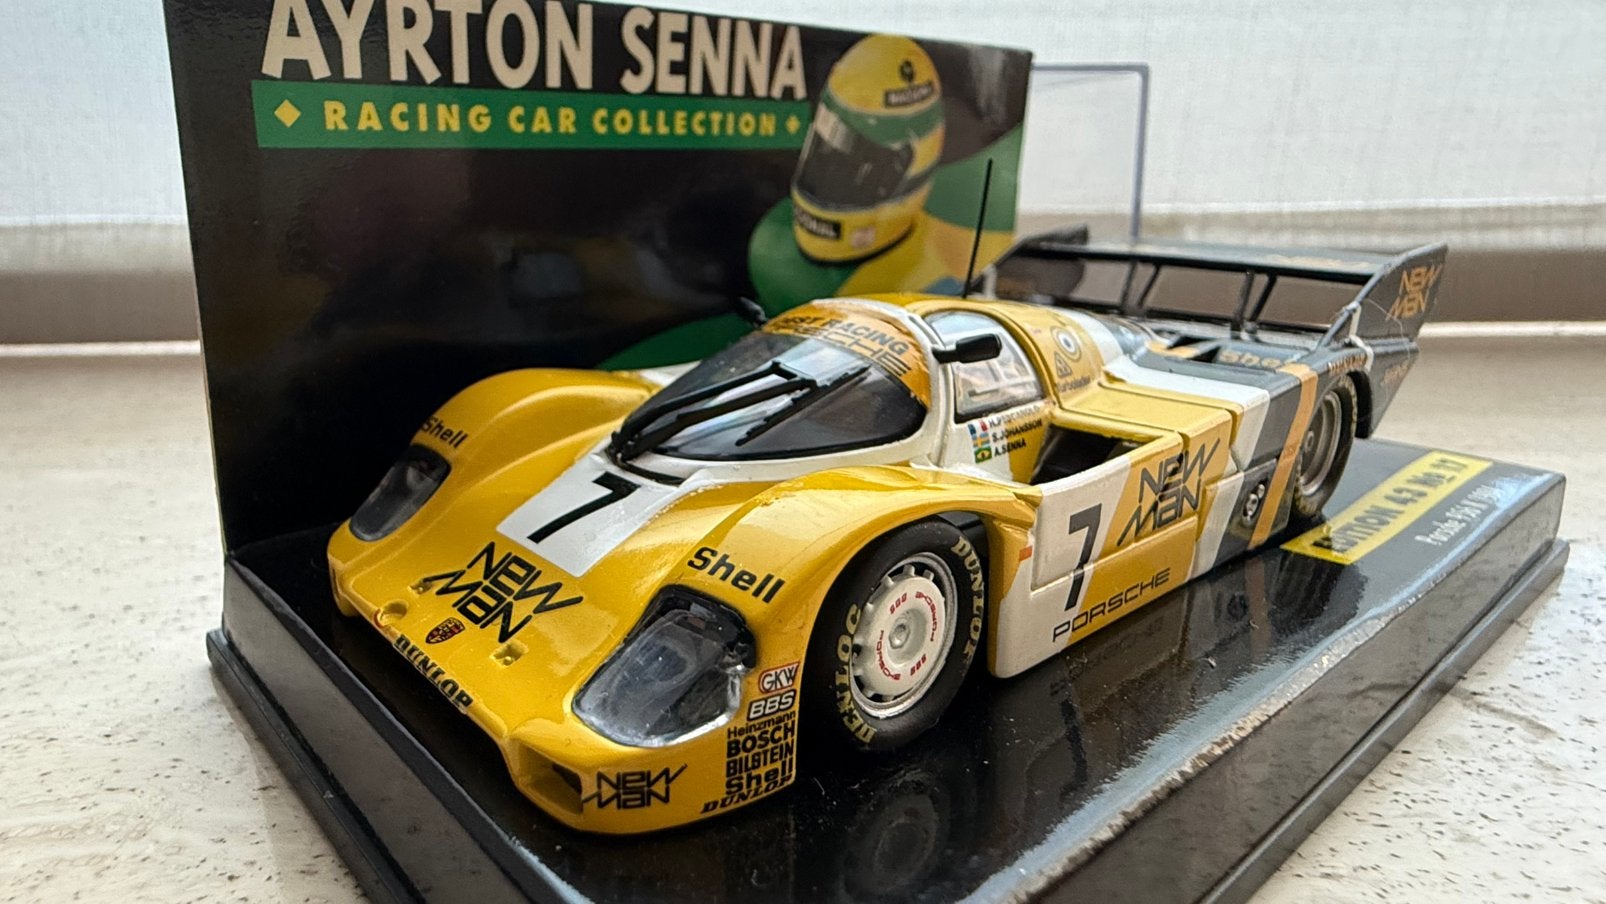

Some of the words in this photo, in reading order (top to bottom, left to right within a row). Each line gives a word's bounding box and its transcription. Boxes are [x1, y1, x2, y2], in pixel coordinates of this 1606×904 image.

[261, 0, 592, 89] AYRTON
[620, 8, 807, 98] SENNA
[324, 100, 492, 131] RACING
[509, 106, 577, 134] CAR
[592, 108, 776, 137] COLLECTION
[821, 319, 909, 356] RACING
[421, 416, 467, 448] Shell
[527, 471, 641, 544] 7
[687, 547, 786, 603] Shell
[1065, 503, 1102, 612] 7
[1053, 568, 1171, 642] PORSCHE
[394, 634, 473, 707] DUNLOP
[761, 665, 798, 691] GKW
[748, 690, 796, 720] BBS
[727, 710, 796, 739] Heinzmann
[727, 723, 795, 758] BOSCH
[726, 739, 794, 777] BILSTEIN
[701, 775, 793, 814] DUNLOP
[726, 759, 794, 795] Shell
